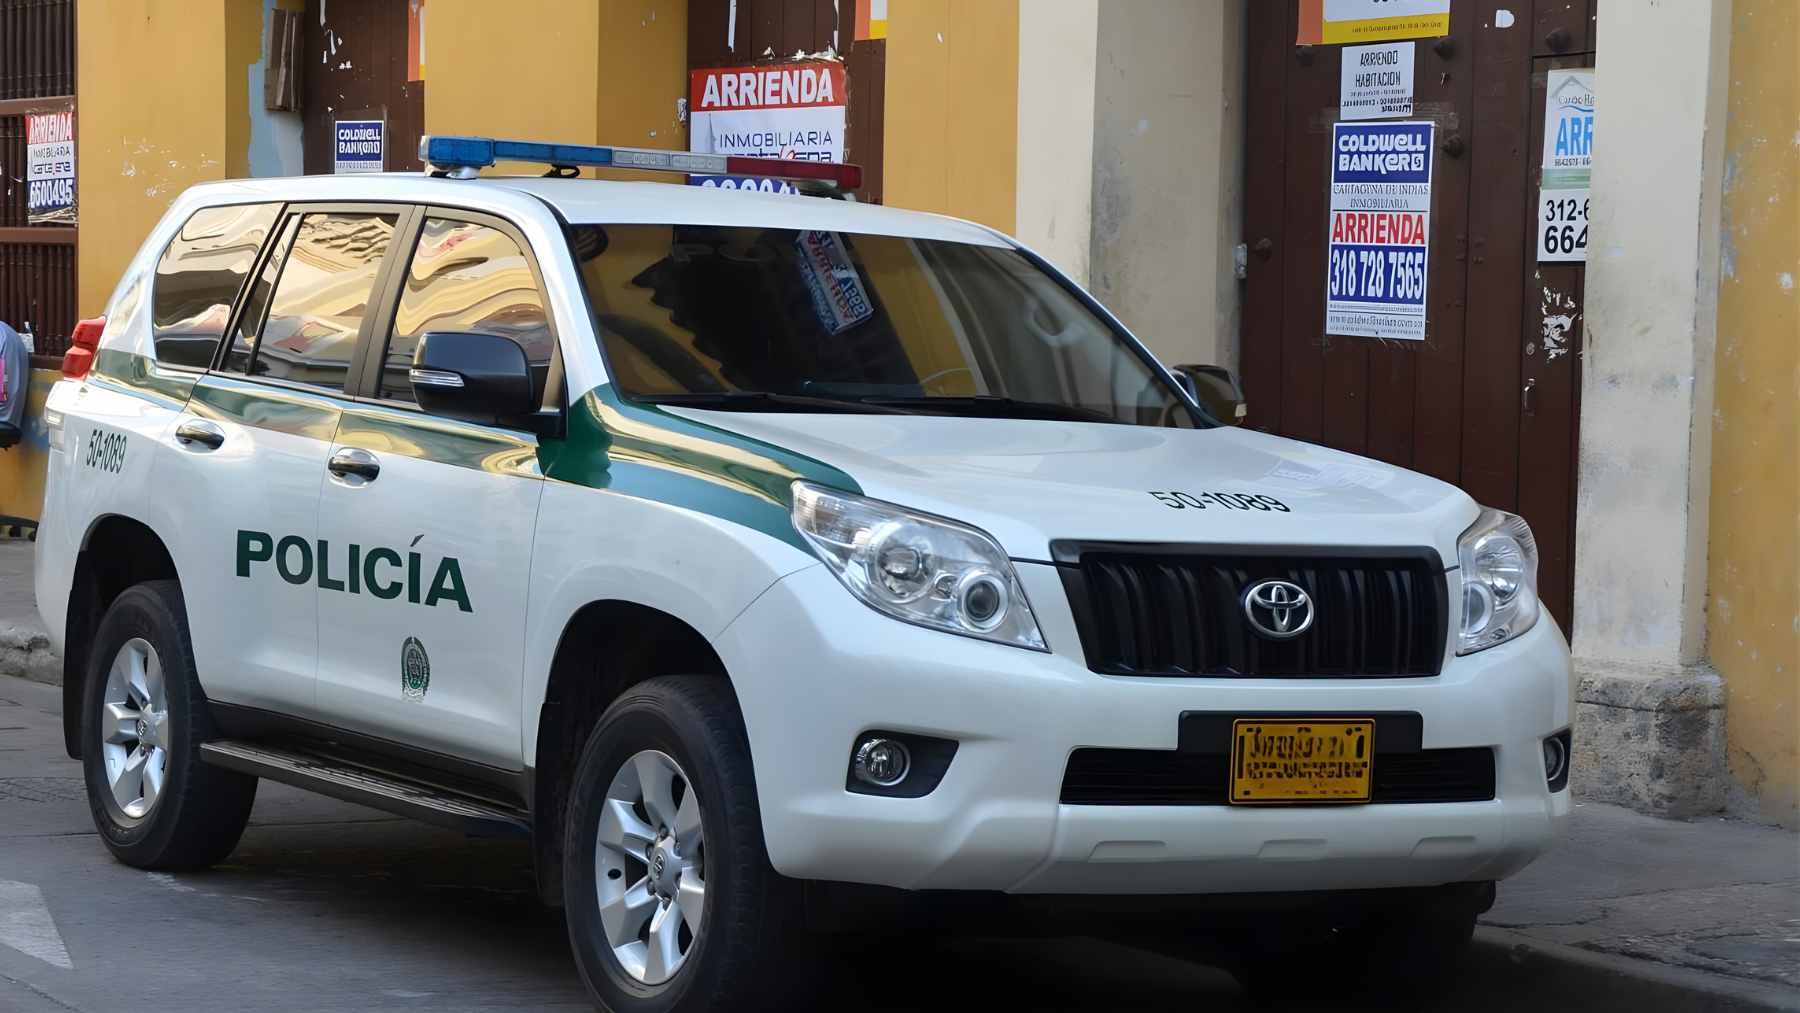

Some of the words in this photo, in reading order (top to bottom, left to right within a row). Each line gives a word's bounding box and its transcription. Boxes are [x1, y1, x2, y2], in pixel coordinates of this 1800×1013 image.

[701, 68, 835, 107] ARRIENDA
[720, 130, 833, 148] INMOBILIARIA
[29, 179, 73, 208] 6600495
[1332, 212, 1425, 245] ARRIENDA
[1331, 249, 1356, 296] 318
[1360, 250, 1384, 298] 728
[1388, 251, 1424, 300] 7565
[86, 429, 127, 474] 50-1089
[1148, 491, 1291, 513] 50-1089
[236, 529, 473, 613] POLICÍA
